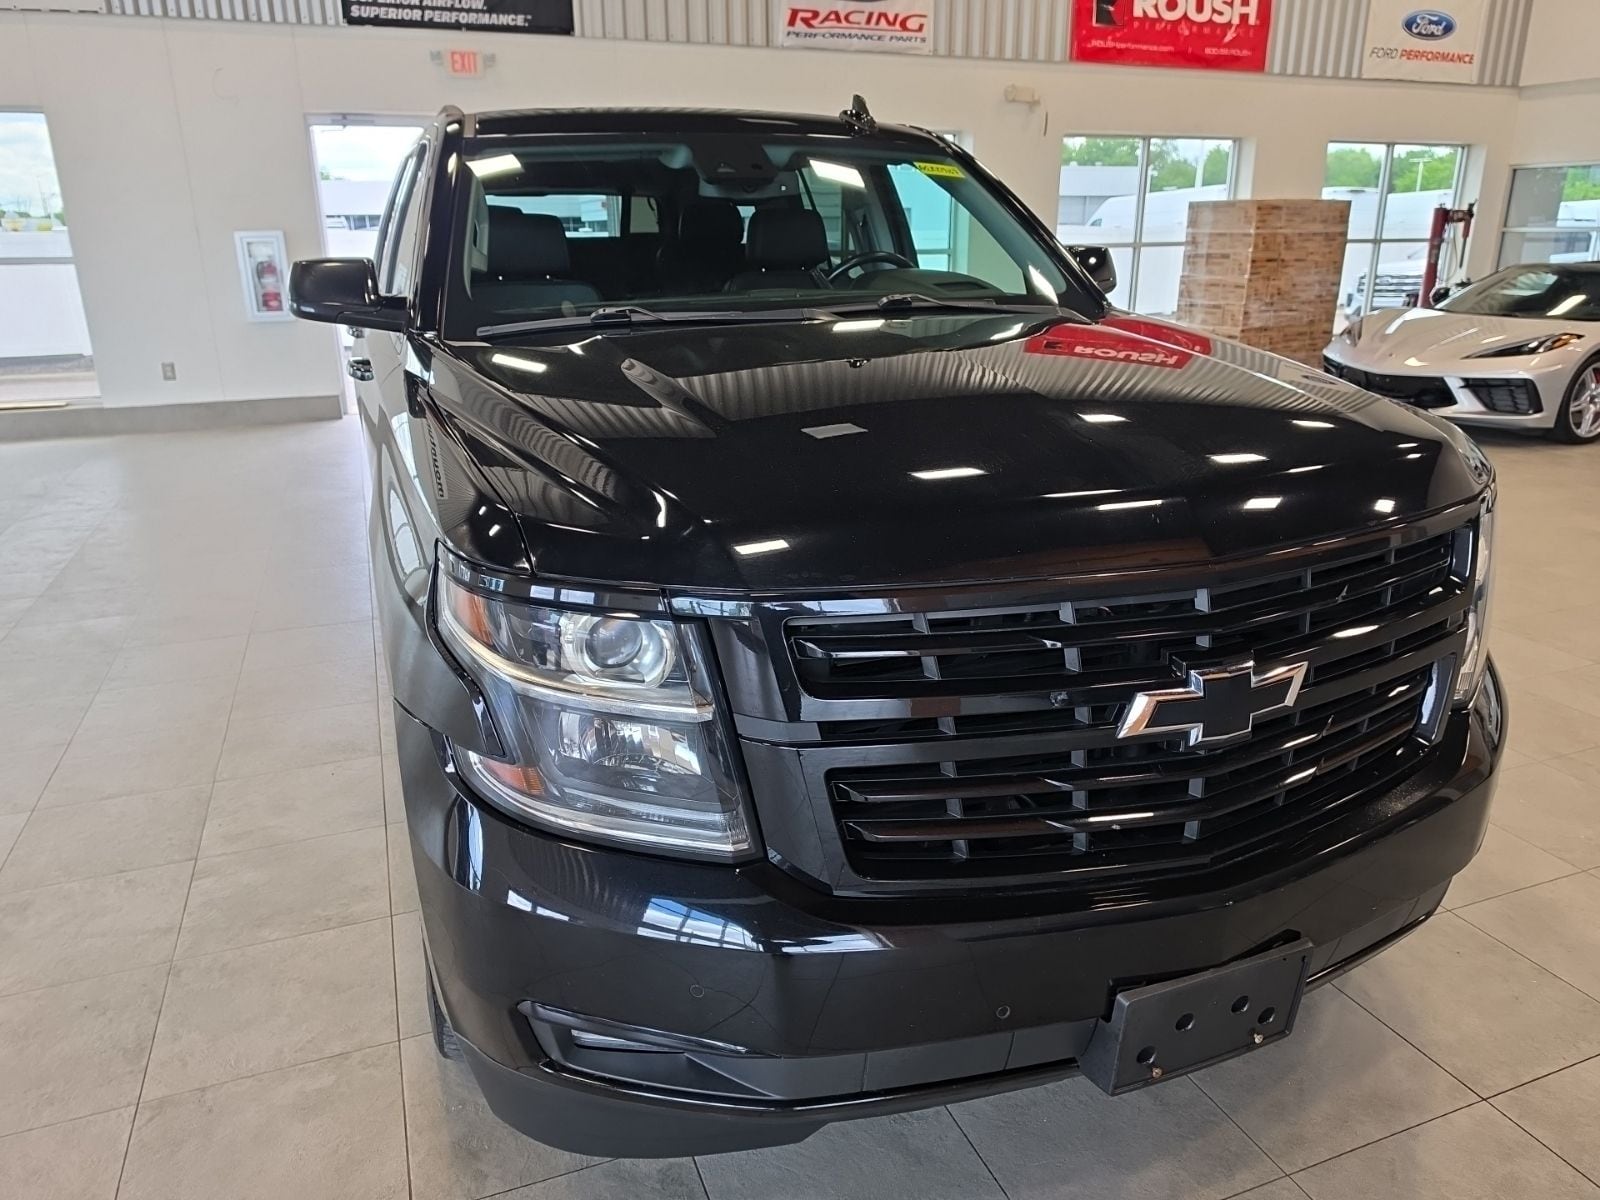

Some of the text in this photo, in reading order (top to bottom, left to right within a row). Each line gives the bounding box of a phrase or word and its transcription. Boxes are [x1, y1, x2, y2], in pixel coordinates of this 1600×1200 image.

[351, 5, 422, 21] SUPERIOR
[787, 8, 927, 33] RACING
[1133, 0, 1257, 25] ROUSH
[1412, 14, 1447, 35] Ford
[786, 31, 886, 41] PERFORMANCE
[450, 51, 477, 73] EXIT
[1369, 47, 1474, 64] FORD PERFORMANCE
